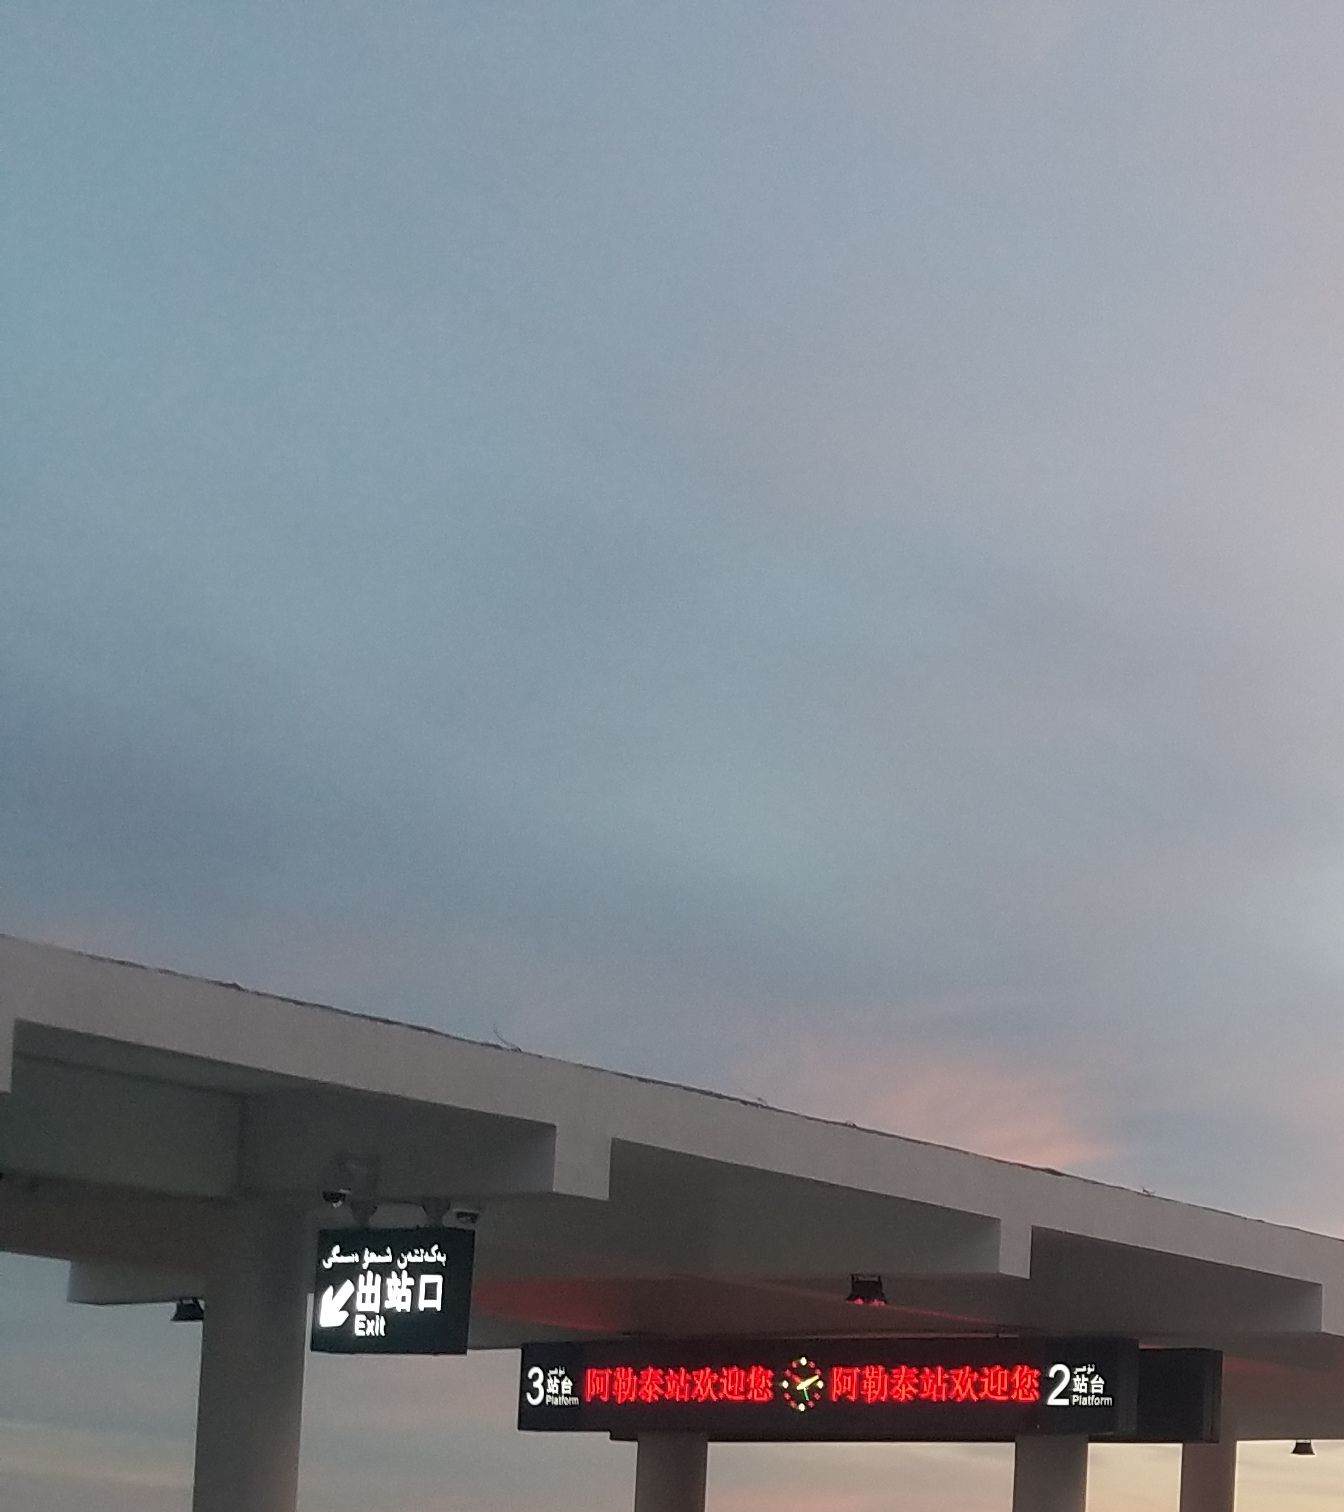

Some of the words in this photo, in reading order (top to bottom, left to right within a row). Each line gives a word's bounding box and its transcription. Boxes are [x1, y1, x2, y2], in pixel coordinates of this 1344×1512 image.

[355, 1270, 444, 1314] 出站口
[354, 1314, 386, 1337] Exit
[526, 1366, 545, 1406] 3
[546, 1375, 574, 1395] 站台
[584, 1365, 775, 1405] 阿勒泰站欢迎您
[829, 1364, 1041, 1404] 阿勒泰站欢迎您
[1046, 1363, 1071, 1406] 2
[1072, 1373, 1105, 1395] 站台
[545, 1394, 580, 1406] Platform
[1072, 1394, 1113, 1407] Platform
